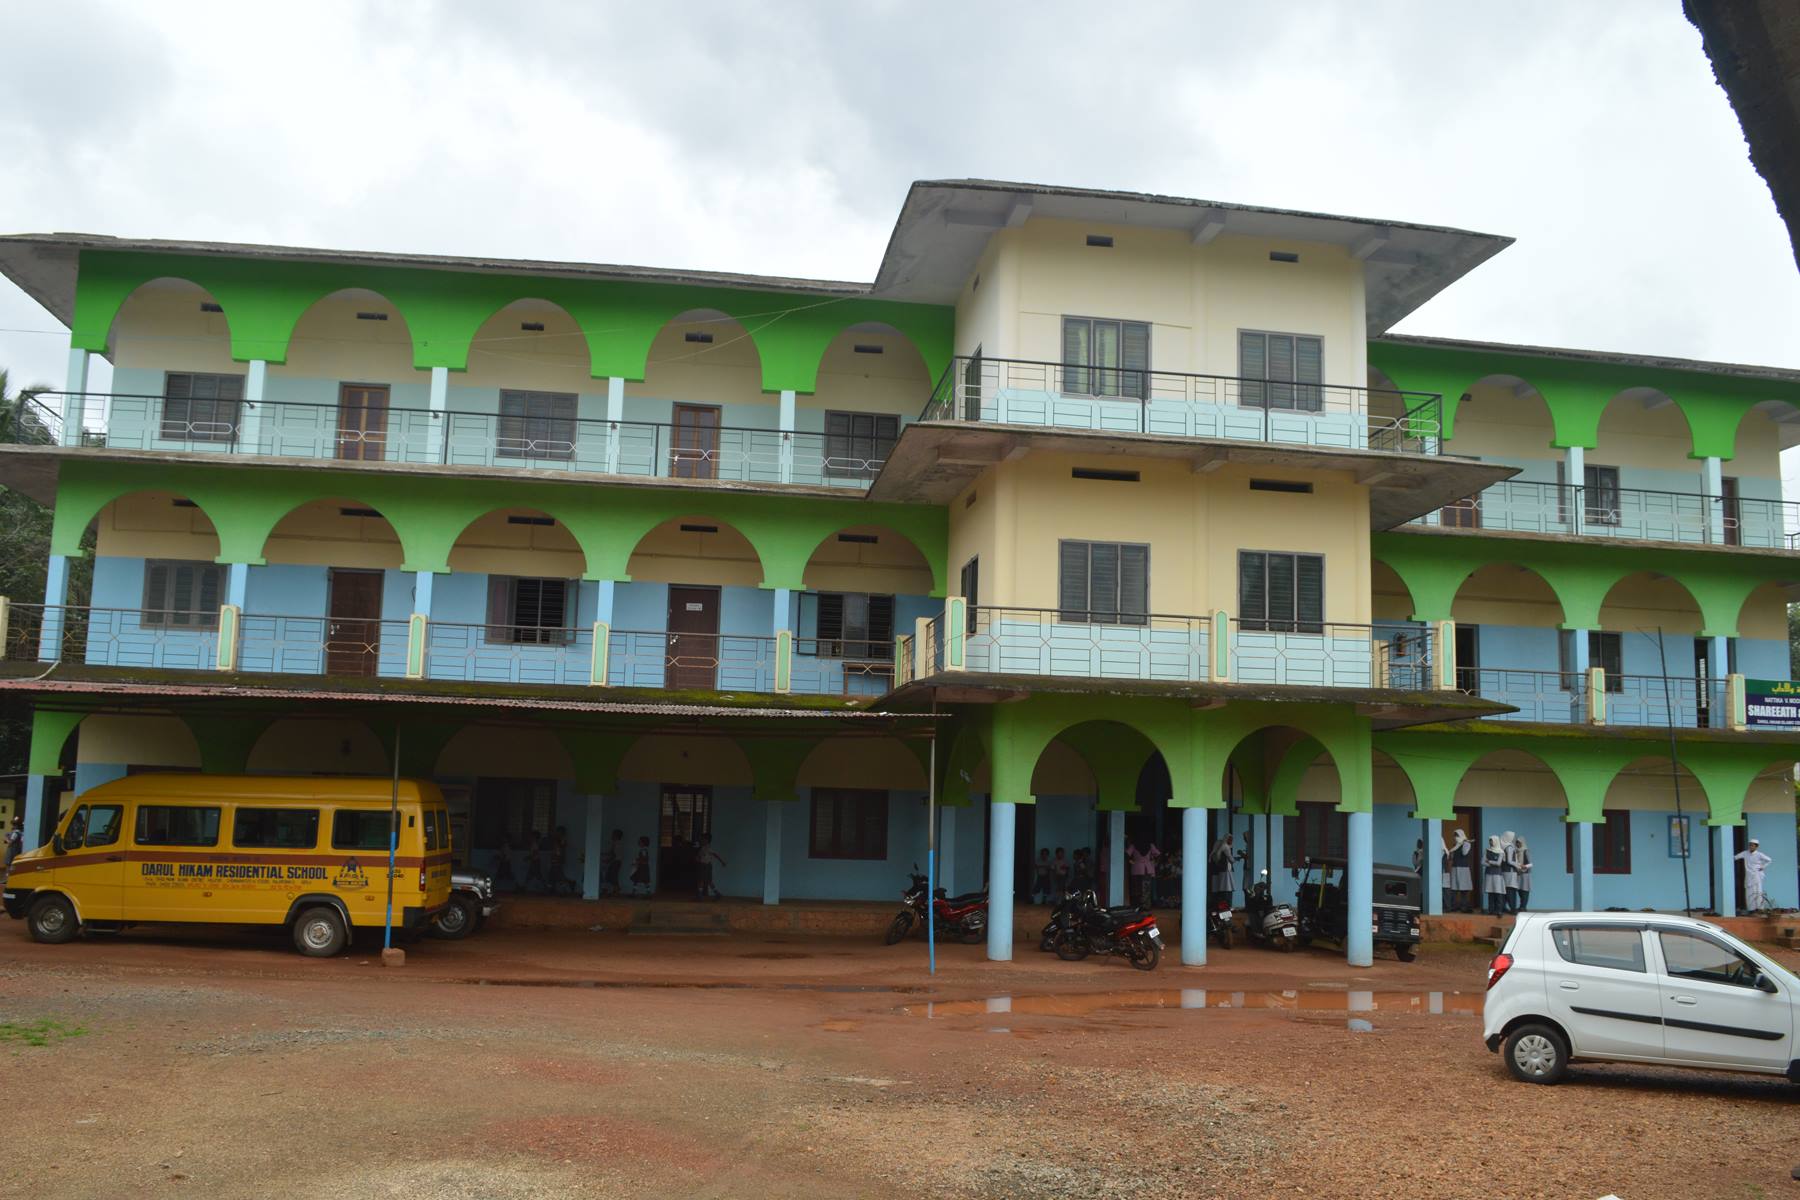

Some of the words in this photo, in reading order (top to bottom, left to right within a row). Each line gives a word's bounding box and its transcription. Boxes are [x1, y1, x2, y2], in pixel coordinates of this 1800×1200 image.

[1748, 705, 1797, 717] SHAREEATH
[142, 863, 175, 876] DARUL
[178, 864, 213, 877] HIKAM
[216, 865, 284, 879] RESIDENTIAL
[287, 866, 328, 880] SCHOOL
